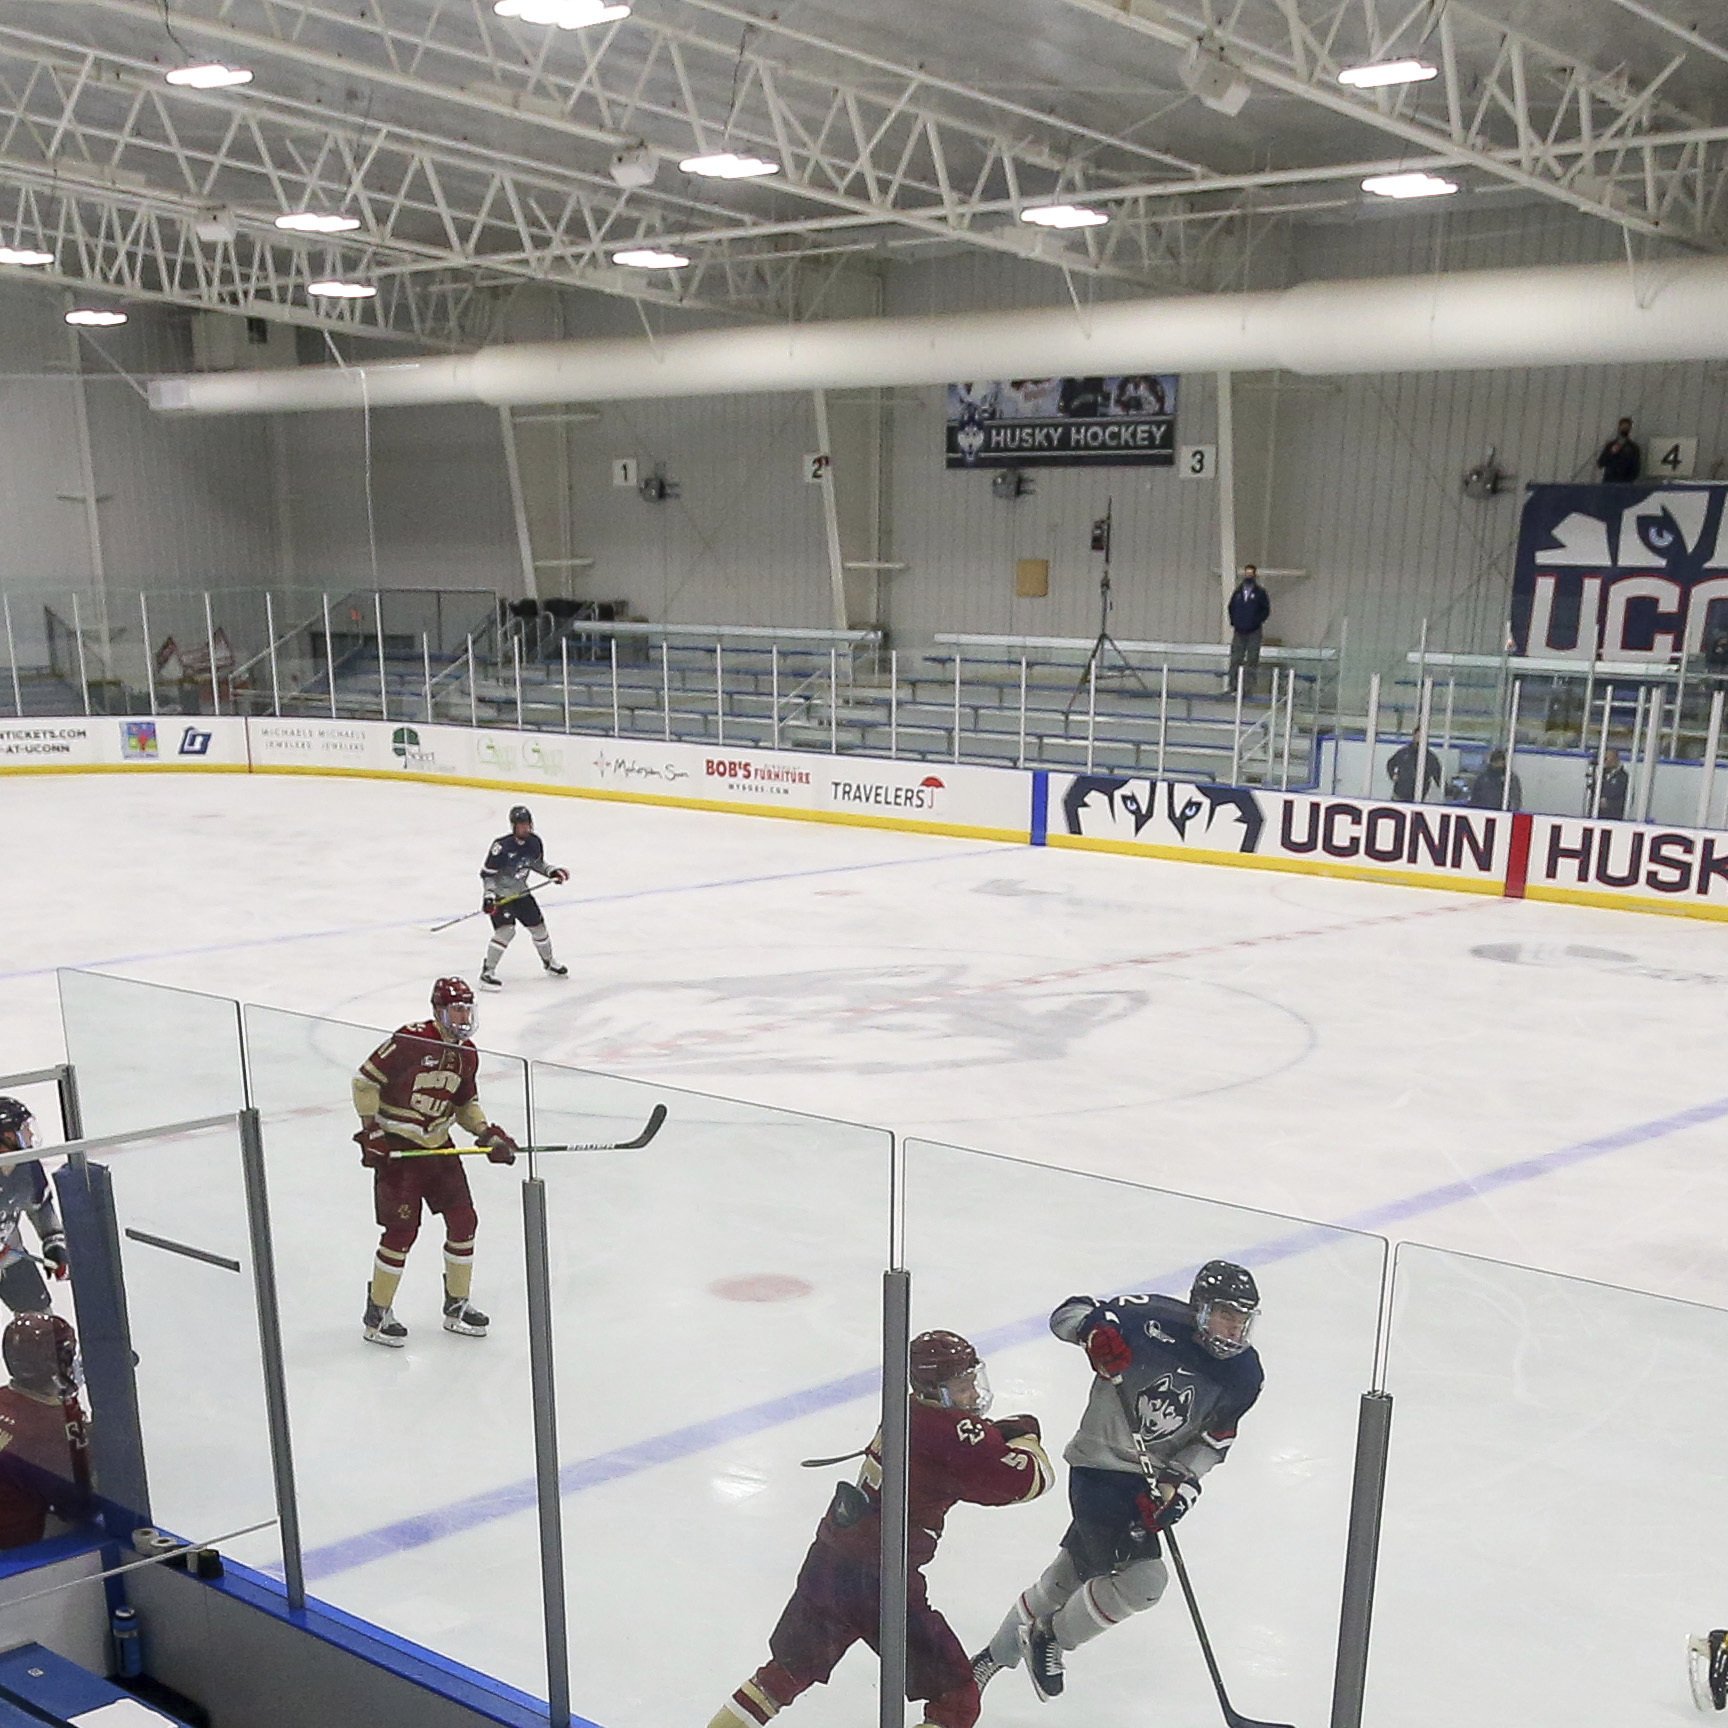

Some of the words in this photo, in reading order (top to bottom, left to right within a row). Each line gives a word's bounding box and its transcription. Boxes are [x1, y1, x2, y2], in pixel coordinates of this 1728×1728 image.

[990, 427, 1063, 449] HUSKY
[1070, 424, 1167, 446] HOCKEY
[811, 456, 822, 479] 2
[1189, 450, 1203, 474] 3
[1660, 443, 1682, 471] 4
[705, 758, 752, 780] BOB'S
[754, 767, 811, 785] FURNITURE
[831, 781, 925, 808] TRAVELERS
[1281, 799, 1496, 872] UCONN
